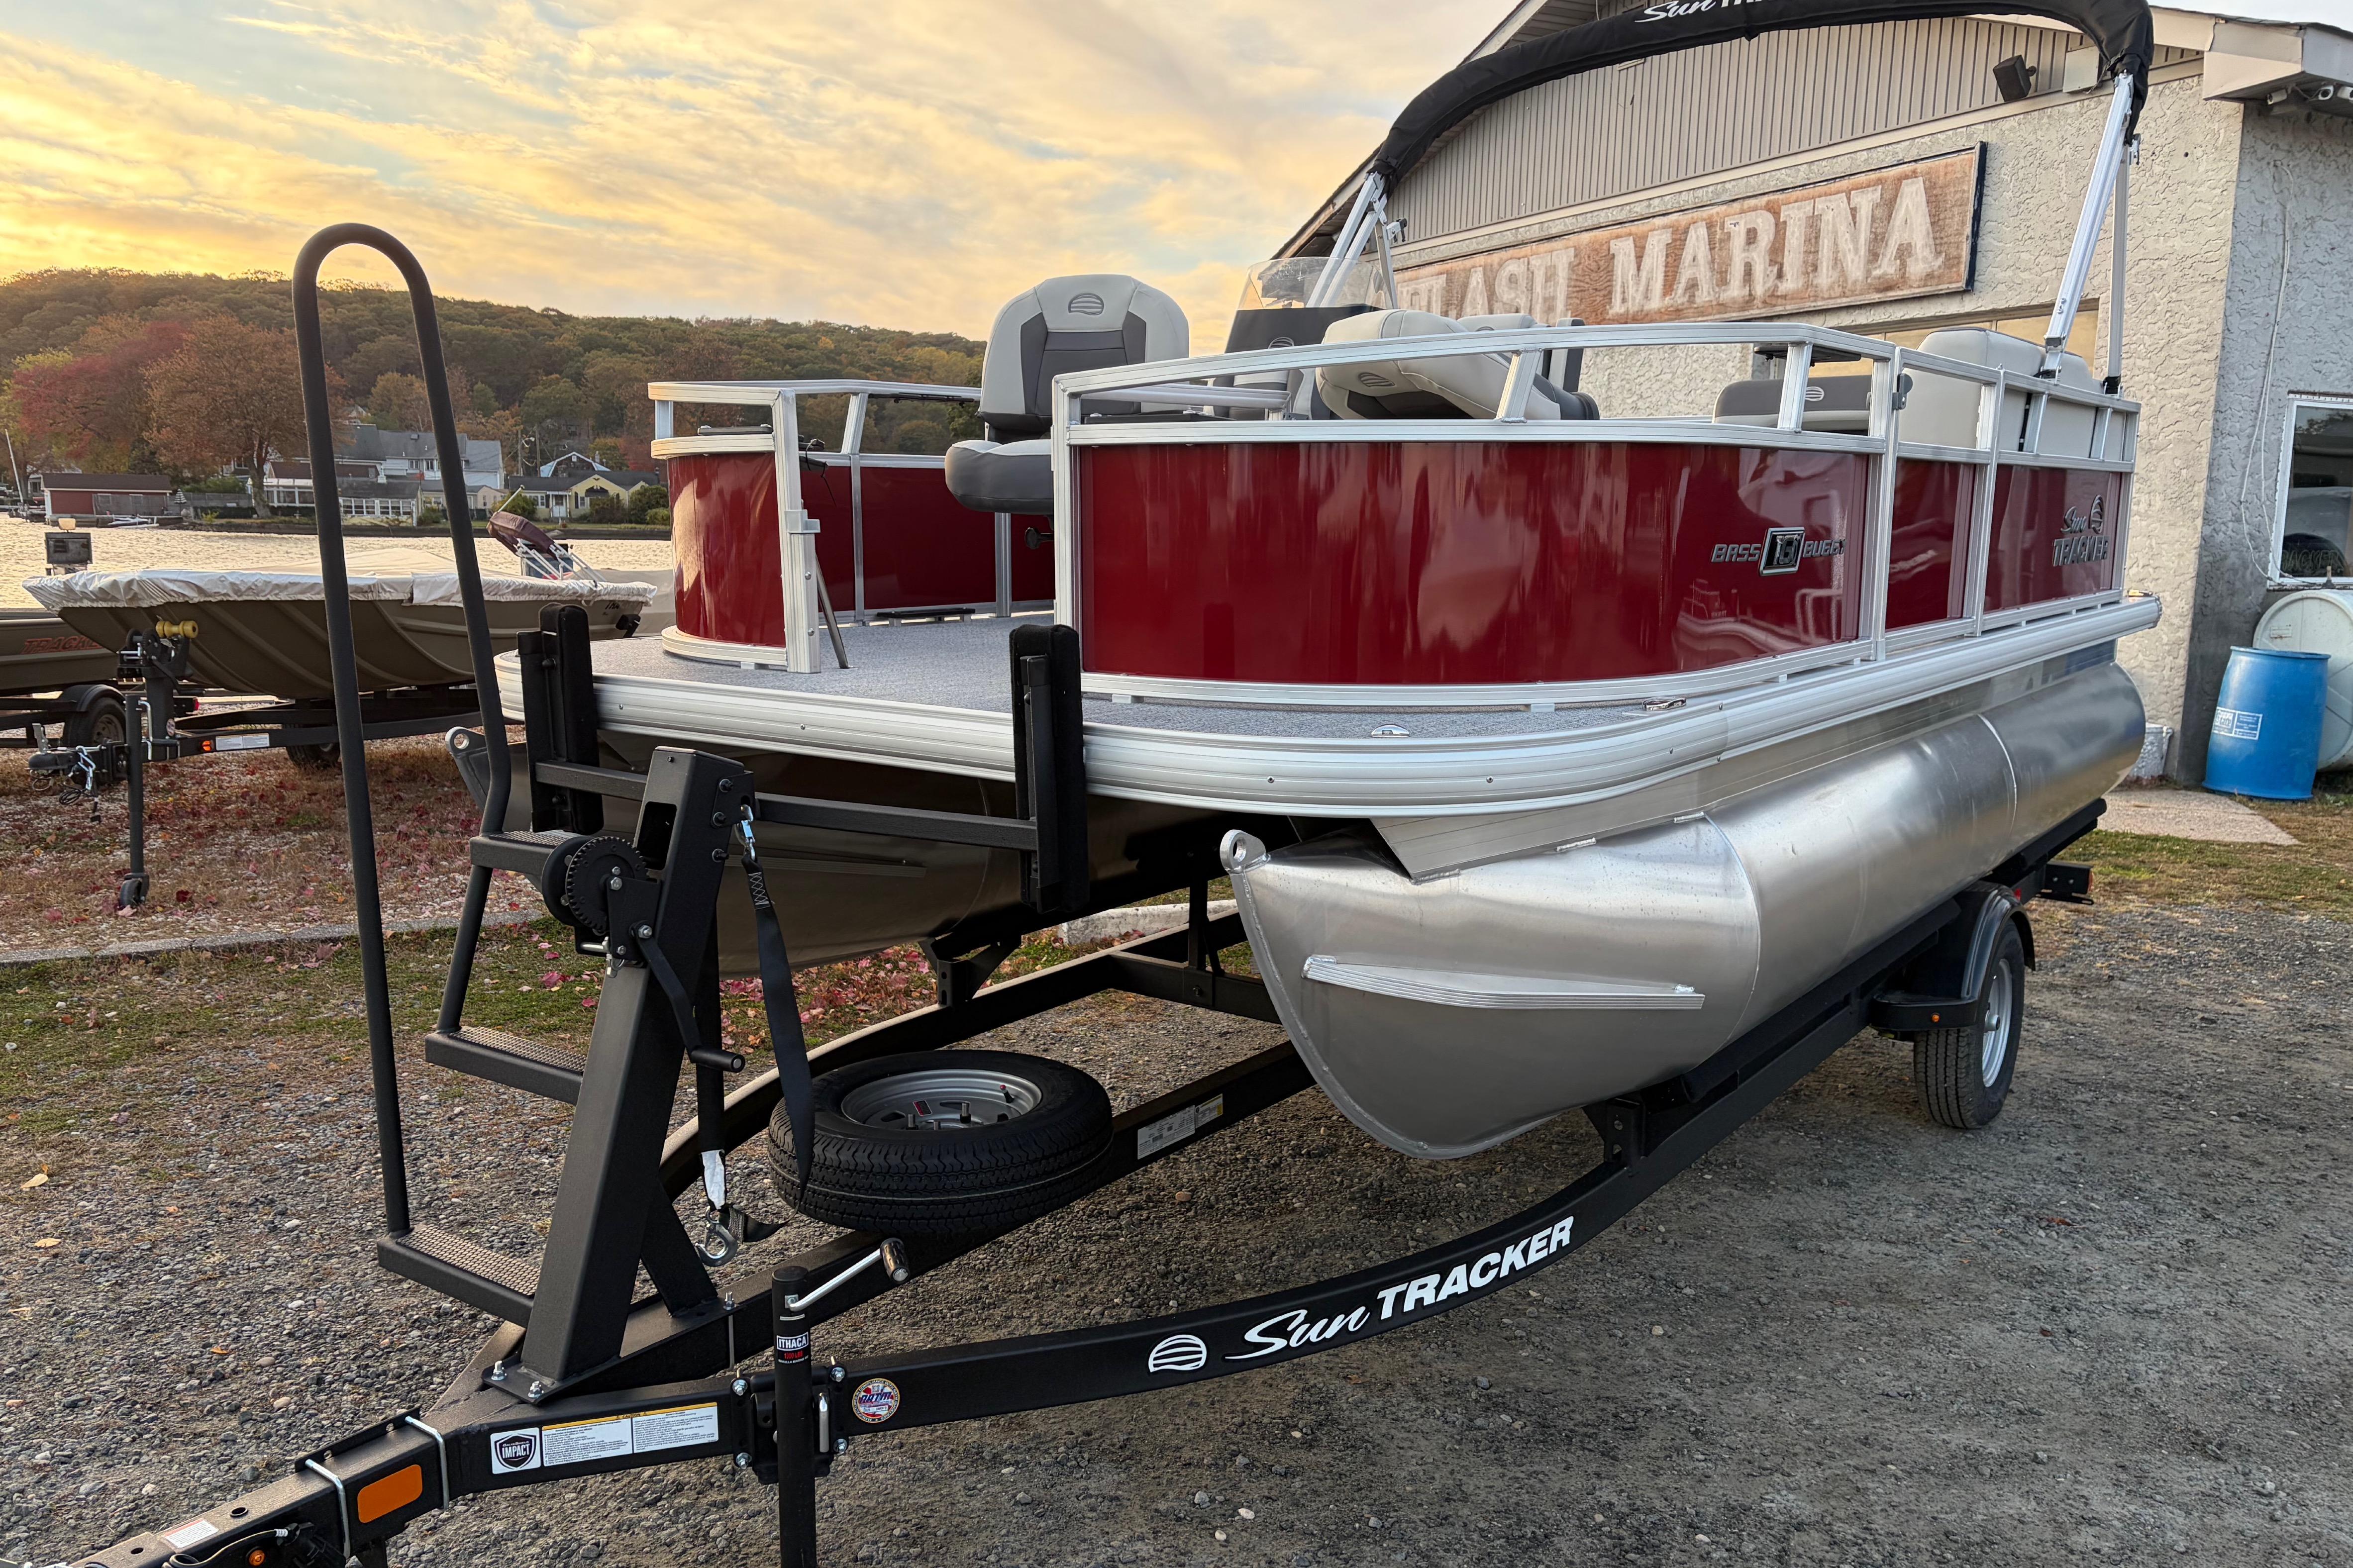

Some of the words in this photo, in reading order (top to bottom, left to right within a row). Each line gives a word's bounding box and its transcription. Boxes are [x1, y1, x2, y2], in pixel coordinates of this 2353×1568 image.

[1635, 0, 1716, 23] Sun
[1608, 176, 1946, 317] MARINA
[2060, 505, 2087, 534] Sun
[1711, 544, 1762, 563] BASS
[2053, 535, 2110, 567] TRACKER
[1225, 1306, 1370, 1360] Sun
[1376, 1215, 1575, 1321] TRACKER
[779, 1336, 807, 1349] ITHACA
[502, 1443, 530, 1459] IMPACT
